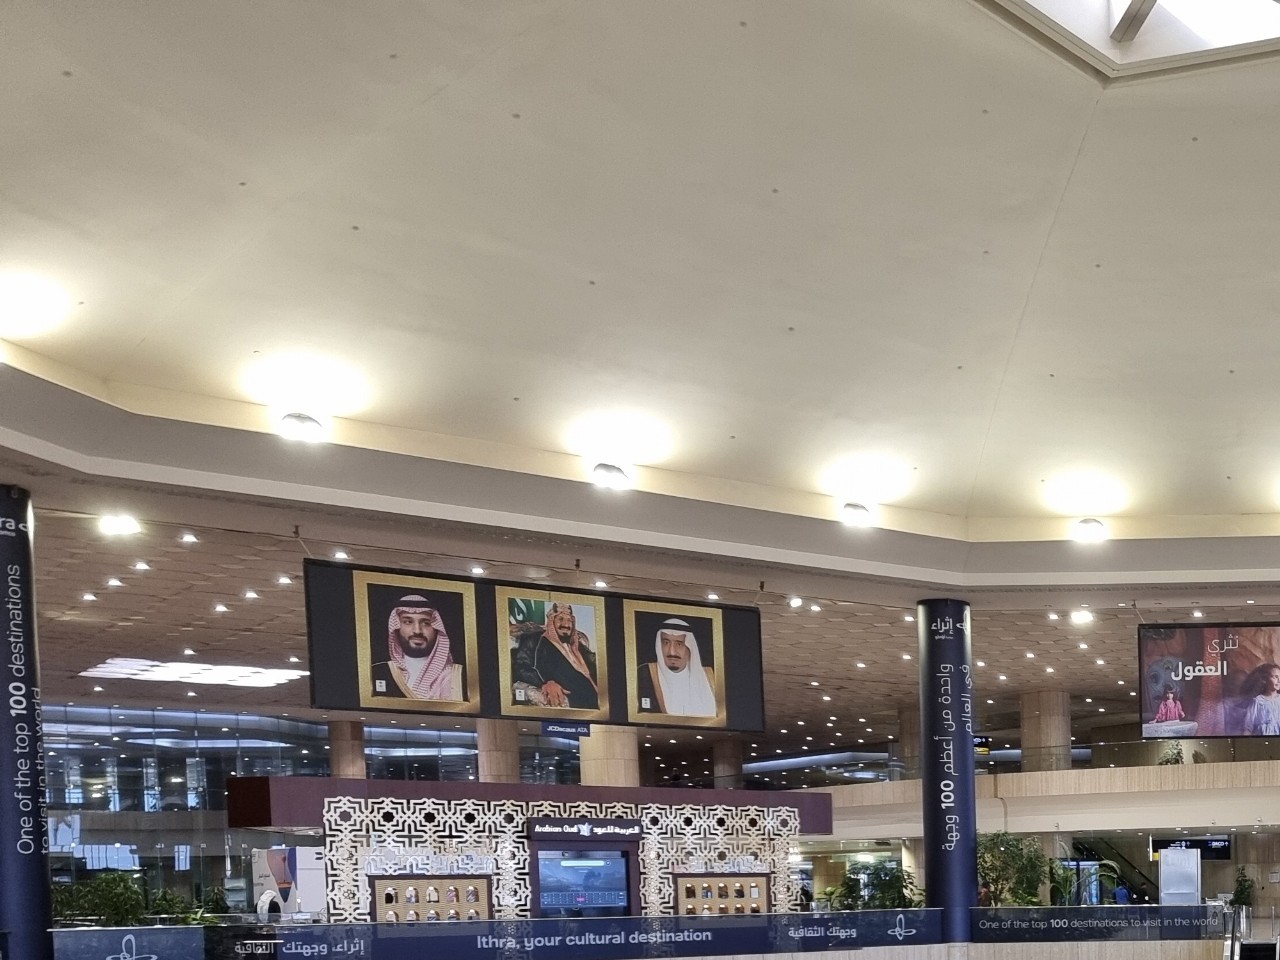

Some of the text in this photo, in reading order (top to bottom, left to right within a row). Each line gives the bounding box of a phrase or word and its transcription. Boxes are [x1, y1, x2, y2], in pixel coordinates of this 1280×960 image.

[931, 616, 954, 634] إثراء
[1208, 634, 1239, 656] نثري
[1171, 661, 1227, 680] العقول
[6, 564, 34, 855] One of the top 100 destinations
[959, 665, 974, 736] في العالم
[934, 664, 960, 850] واحدة من أعظم 100 وجهة
[534, 824, 578, 833] Arabian Oud
[788, 925, 857, 939] وجهتك الثقافية
[979, 916, 1218, 930] One of the top 100 destinations to visit in the world
[282, 941, 328, 956] وجهتك
[477, 929, 712, 950] Ithra, your cultural destination
